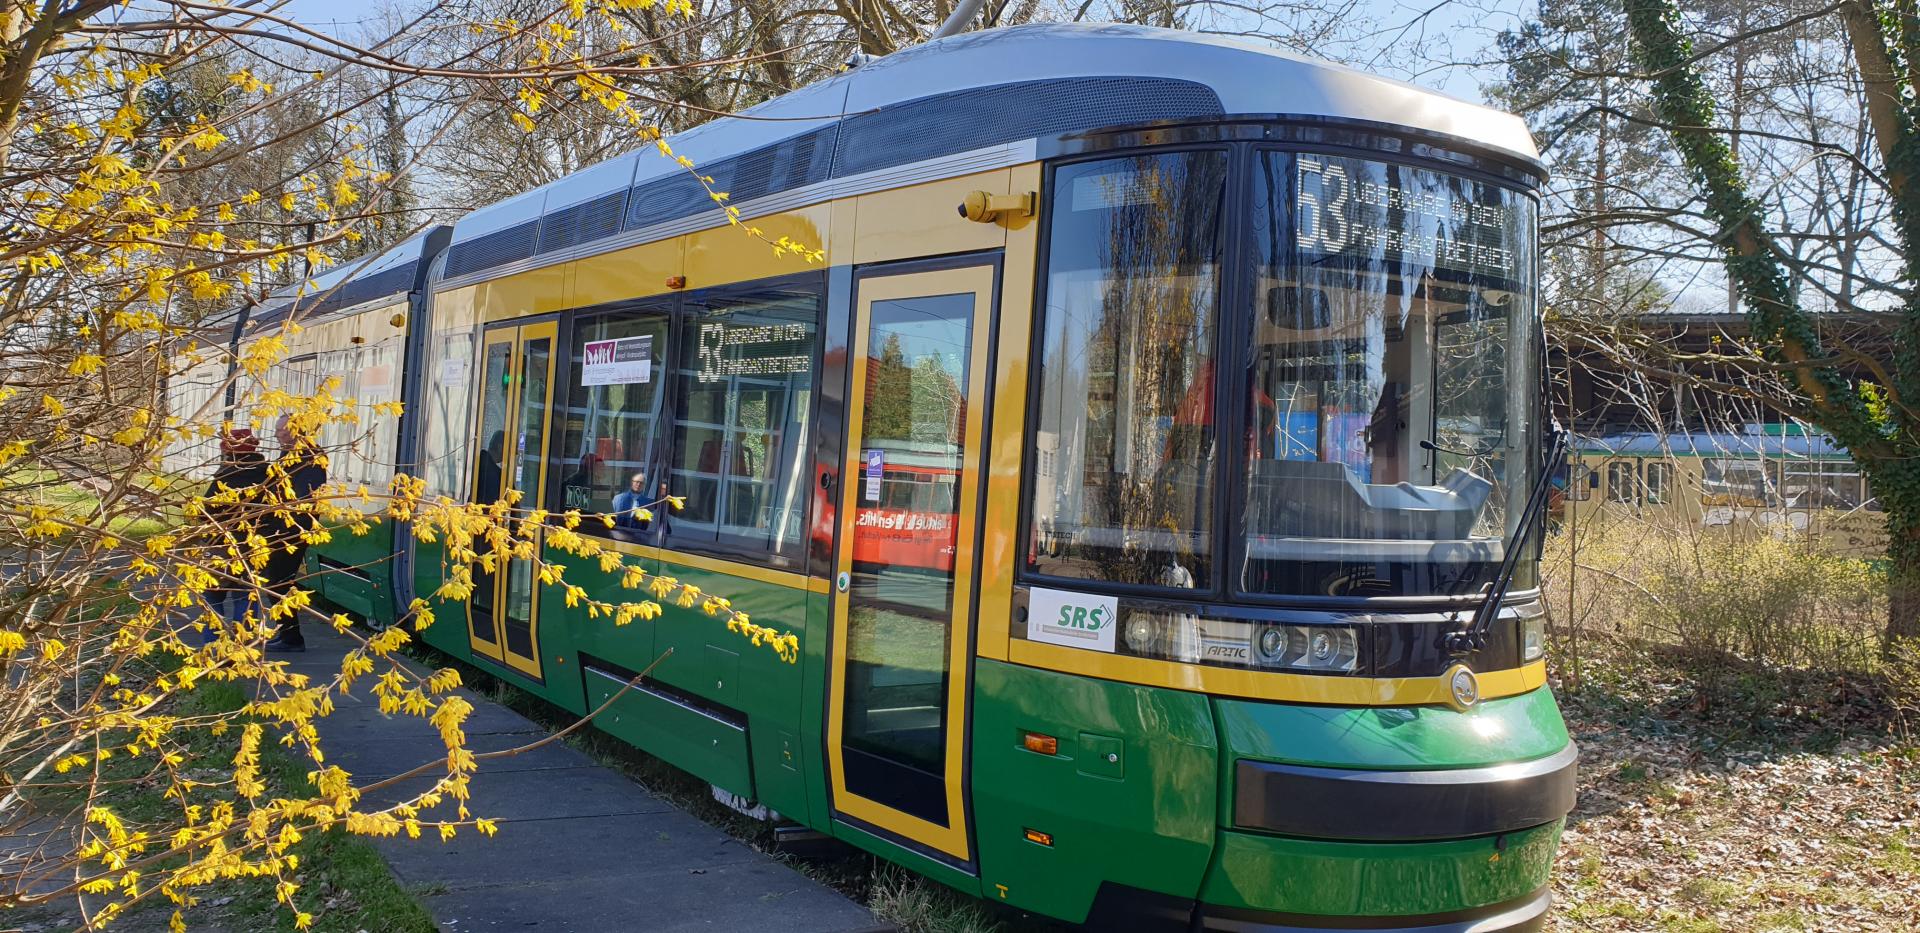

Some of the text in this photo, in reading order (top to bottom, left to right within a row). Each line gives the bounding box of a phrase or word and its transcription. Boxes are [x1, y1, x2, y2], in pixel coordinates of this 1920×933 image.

[1297, 158, 1348, 253] 53
[1353, 180, 1504, 230] ÜBERGABE IN DEN
[1351, 223, 1513, 270] FAHRGASTBETRIEB
[785, 322, 806, 341] DEN
[698, 323, 724, 383] 53
[722, 355, 810, 375] FAHRGASTBETRIEB
[1057, 604, 1103, 630] SRS
[1207, 645, 1247, 658] ARTIC
